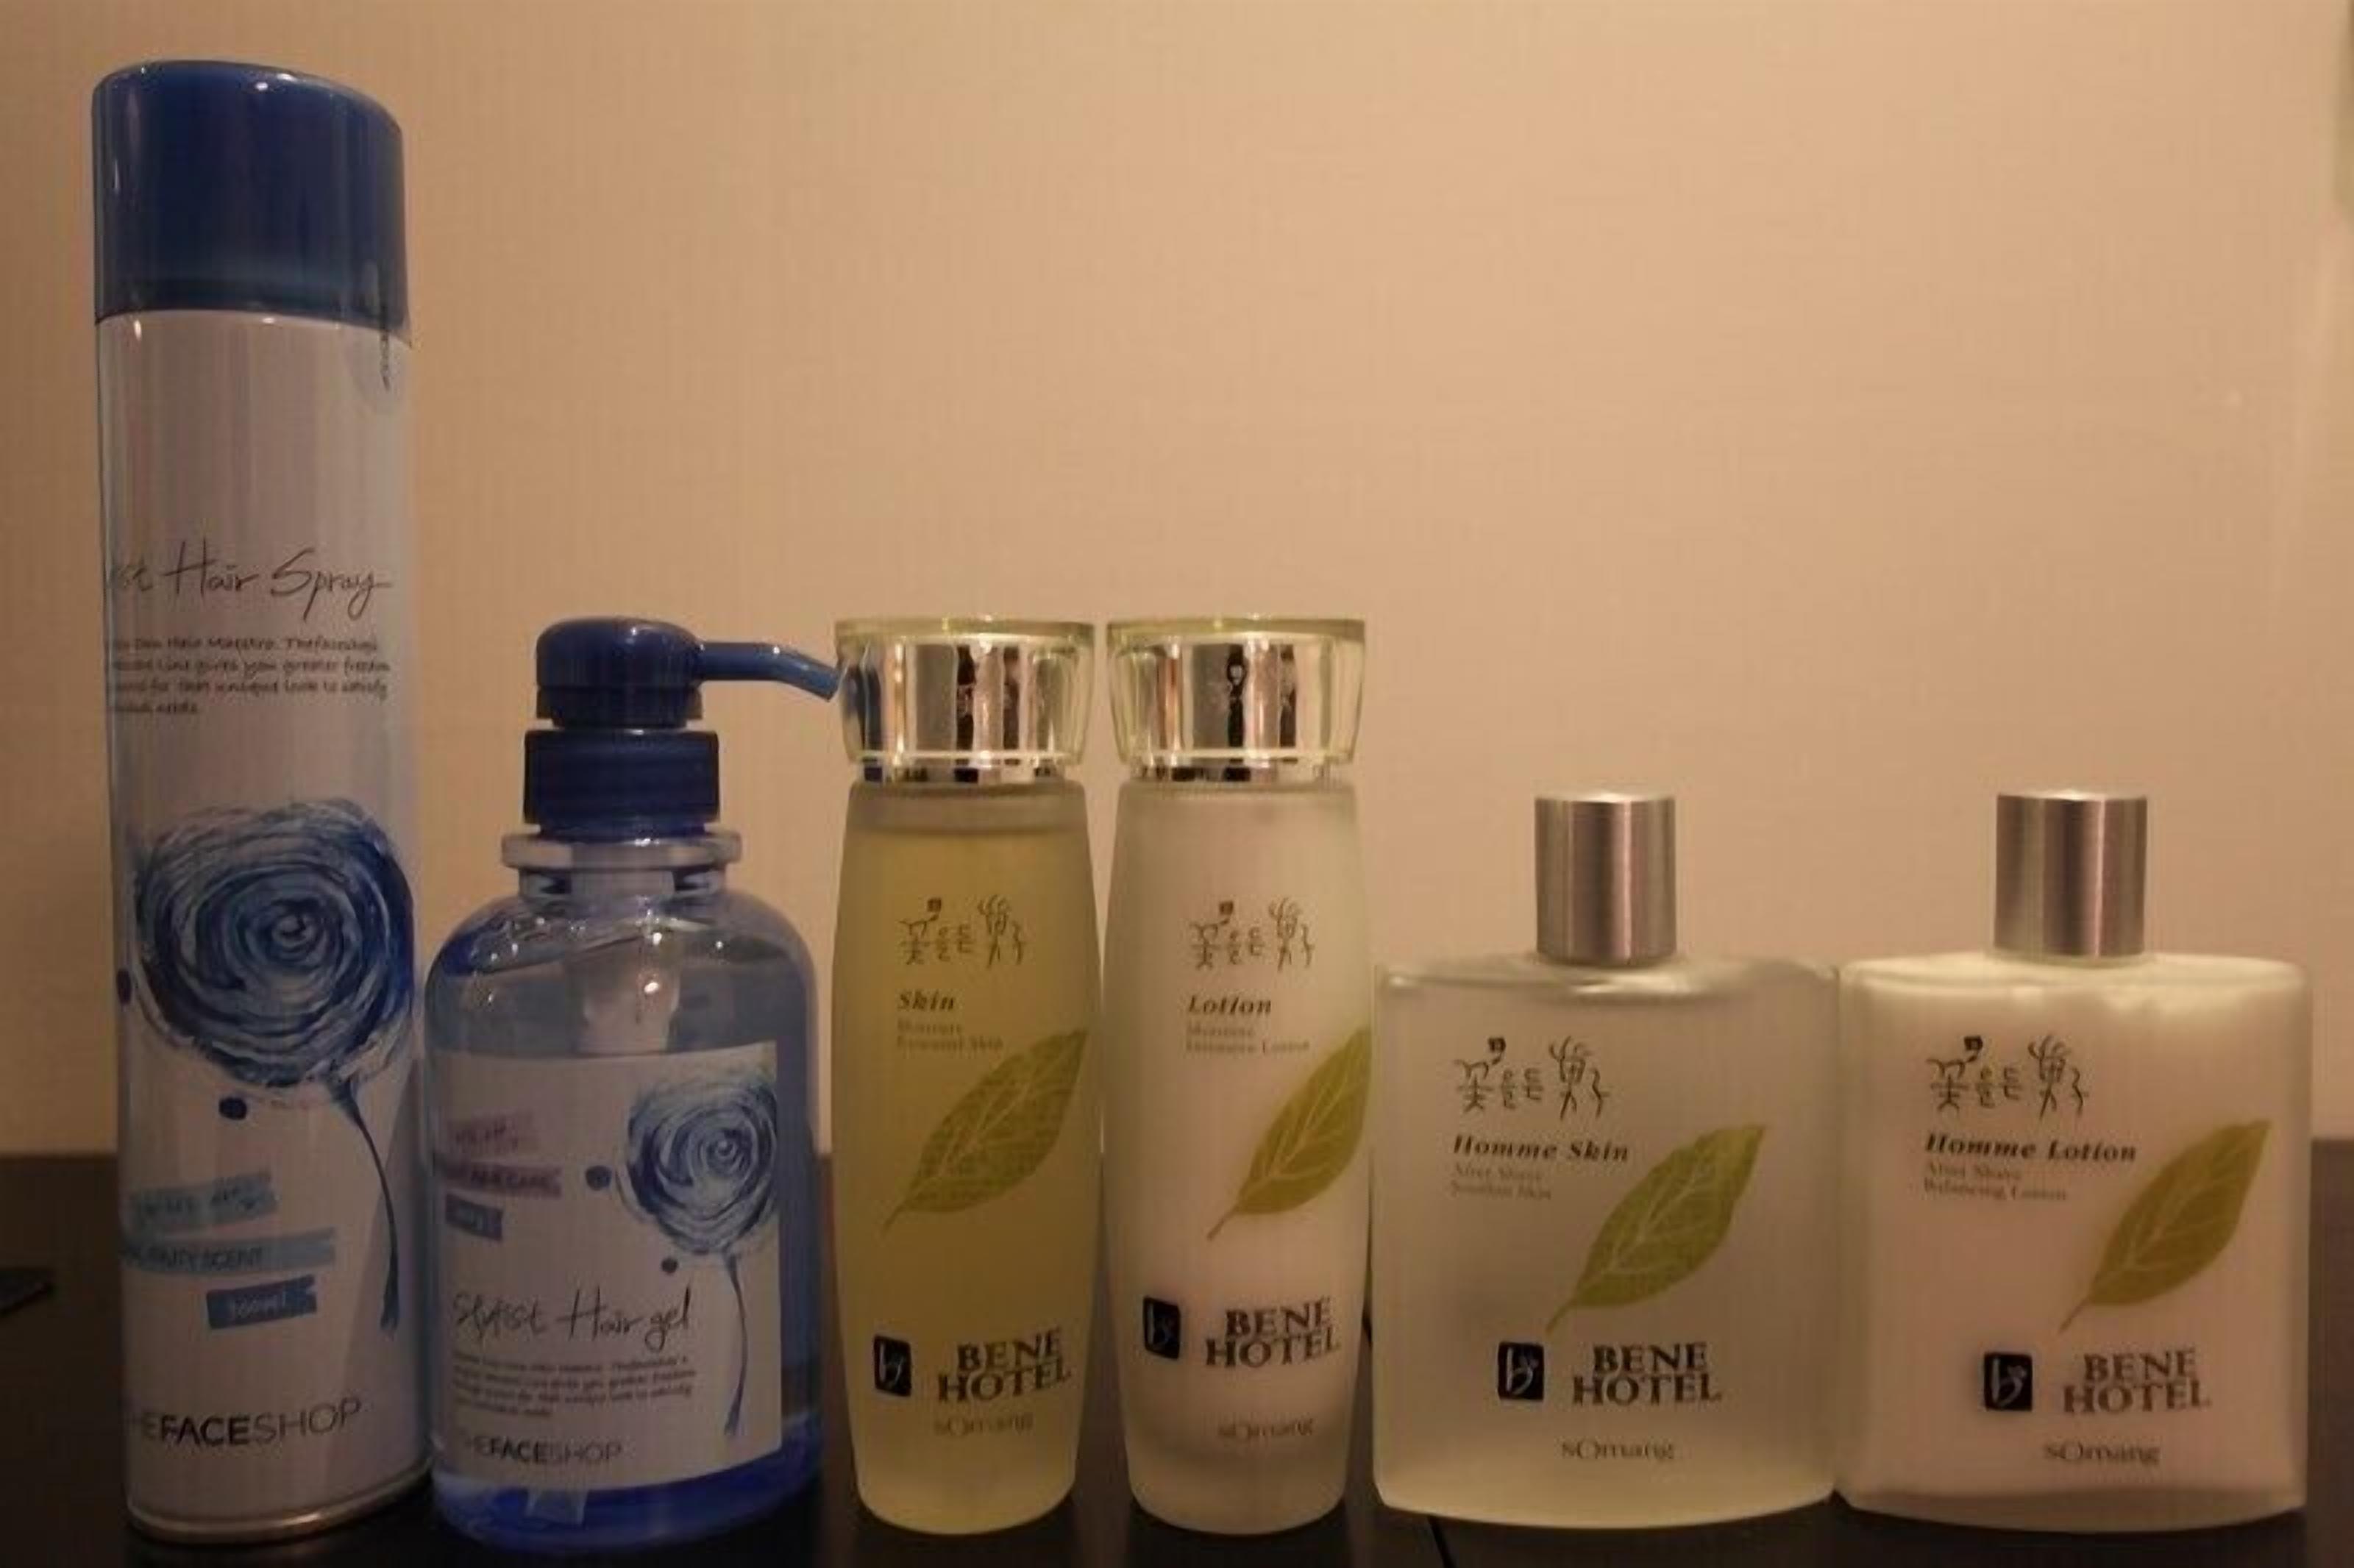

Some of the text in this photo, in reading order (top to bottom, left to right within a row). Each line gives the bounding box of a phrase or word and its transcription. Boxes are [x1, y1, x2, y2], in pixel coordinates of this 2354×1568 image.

[163, 538, 260, 603] Hair
[269, 546, 392, 621] Spray
[897, 990, 955, 1012] Skin
[1187, 994, 1272, 1016] Lotion
[1453, 1134, 1629, 1162] Homme Skin
[1925, 1133, 2137, 1163] Homme Lotion
[556, 1285, 643, 1342] Hair
[644, 1284, 691, 1353] gel
[1226, 1294, 1332, 1337] BENE
[957, 1325, 1062, 1371] BENE
[1205, 1327, 1342, 1367] HOTEL
[1593, 1342, 1709, 1373] BENE
[2083, 1347, 2197, 1383] BENE
[937, 1353, 1073, 1403] HOTEL
[1573, 1372, 1723, 1406] HOTEL
[2063, 1378, 2213, 1414] HOTEL
